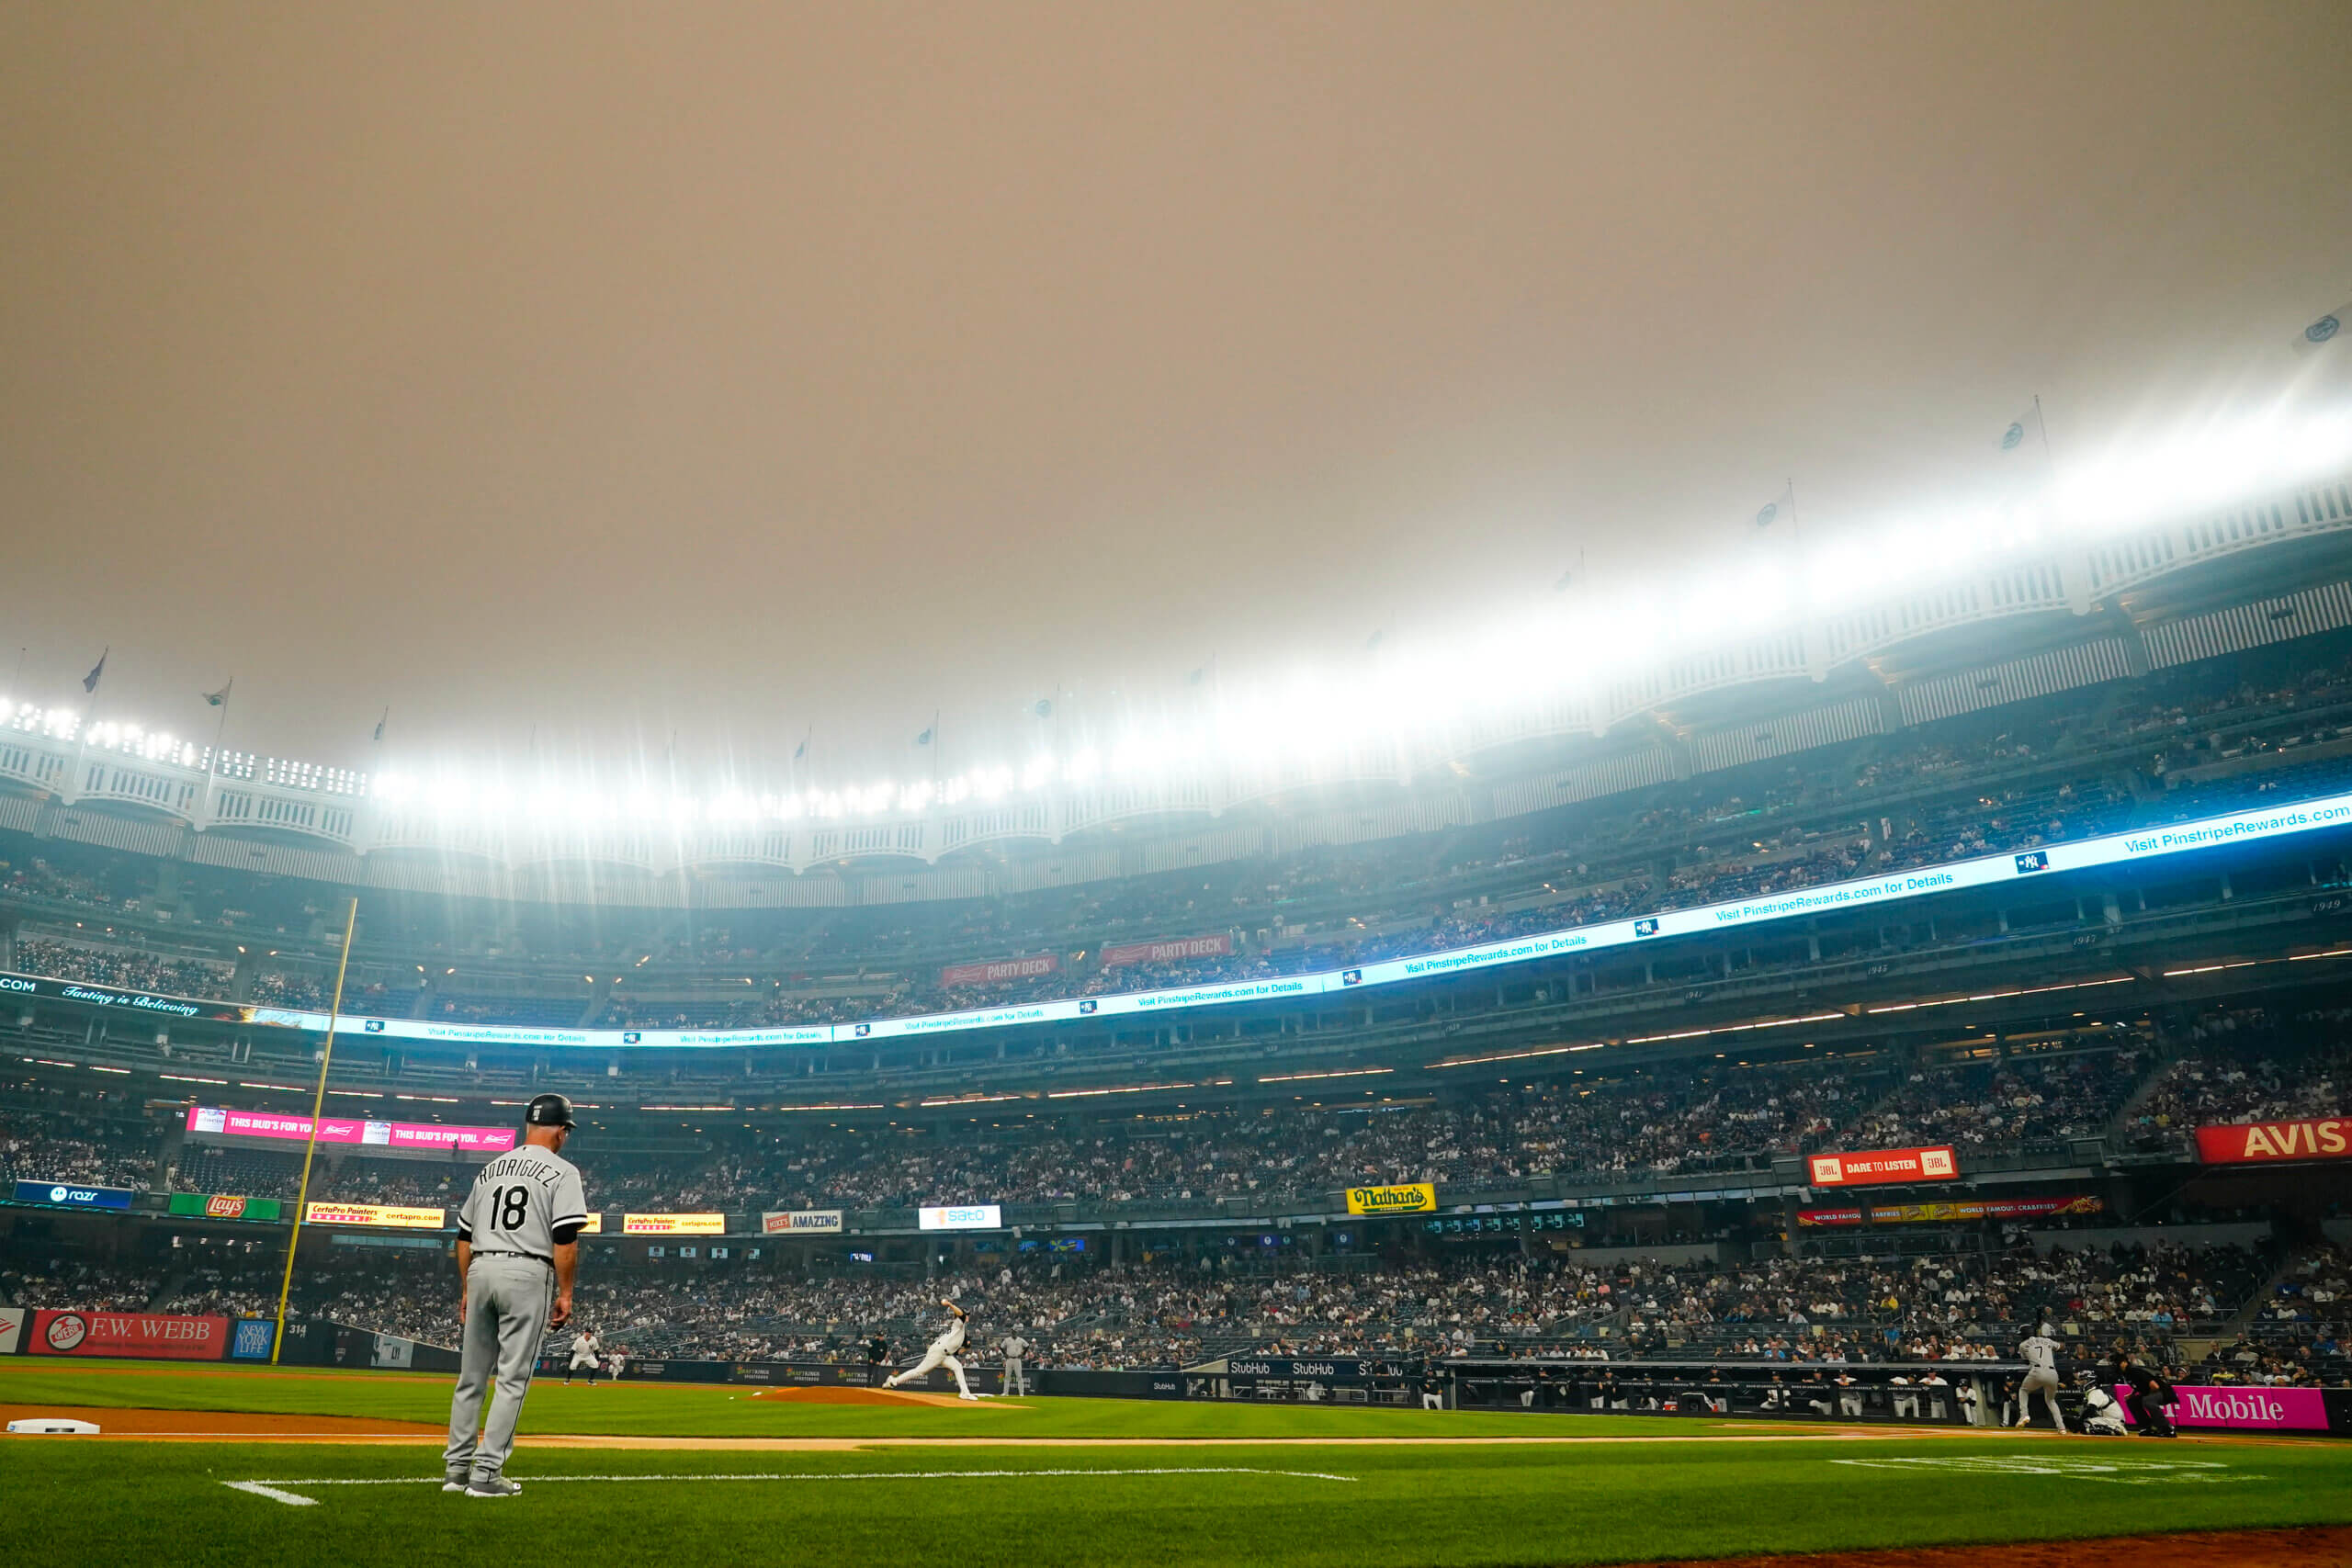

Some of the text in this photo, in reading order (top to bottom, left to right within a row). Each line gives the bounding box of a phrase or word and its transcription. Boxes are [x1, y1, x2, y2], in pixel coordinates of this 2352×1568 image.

[2125, 806, 2350, 853] Visit PinstripeRewards.com
[1716, 873, 1953, 921] Visit PinstripeRewards.com for Details
[1152, 942, 1188, 959] PARTY
[1190, 937, 1222, 954] DECK
[1405, 935, 1588, 974] Visit PinstripeRewards.com for Details
[988, 963, 1021, 978] PARTY
[1023, 960, 1050, 975] DECK
[62, 986, 199, 1016] Tasting is Believing
[1138, 982, 1304, 1007] Visit PinstripeRewards.com for Details
[231, 1117, 251, 1128] THIS
[252, 1118, 278, 1130] BUD'S
[280, 1123, 298, 1132] FOR
[395, 1130, 414, 1140] THIS
[416, 1131, 441, 1141] BUD'S
[442, 1132, 459, 1142] FOR
[460, 1134, 479, 1143] YOU.
[2244, 1121, 2346, 1156] AVIS
[1846, 1159, 1917, 1174] DARE TO LISTEN
[1927, 1157, 1947, 1168] JBL
[479, 1158, 561, 1188] RODRIGUEZ
[1819, 1165, 1838, 1176] JBL
[69, 1190, 98, 1201] razr
[1353, 1187, 1428, 1207] Nathan's
[209, 1196, 243, 1215] Lay's
[490, 1184, 530, 1232] 18
[312, 1205, 441, 1222] CertaPro Painters certapro.com
[769, 1215, 838, 1228] MIKE'S AMAZING
[53, 1325, 80, 1340] WEBB
[89, 1318, 210, 1340] F.W. WEBB
[242, 1325, 266, 1335] NEW
[289, 1325, 307, 1335] 314
[239, 1333, 267, 1345] YORK
[240, 1343, 265, 1354] LIFE
[2034, 1346, 2043, 1360] 7
[1231, 1361, 1270, 1374] StubHub
[1293, 1362, 1334, 1376] StubHub
[1153, 1382, 1176, 1391] StubHub
[2187, 1393, 2285, 1421] Mobile
